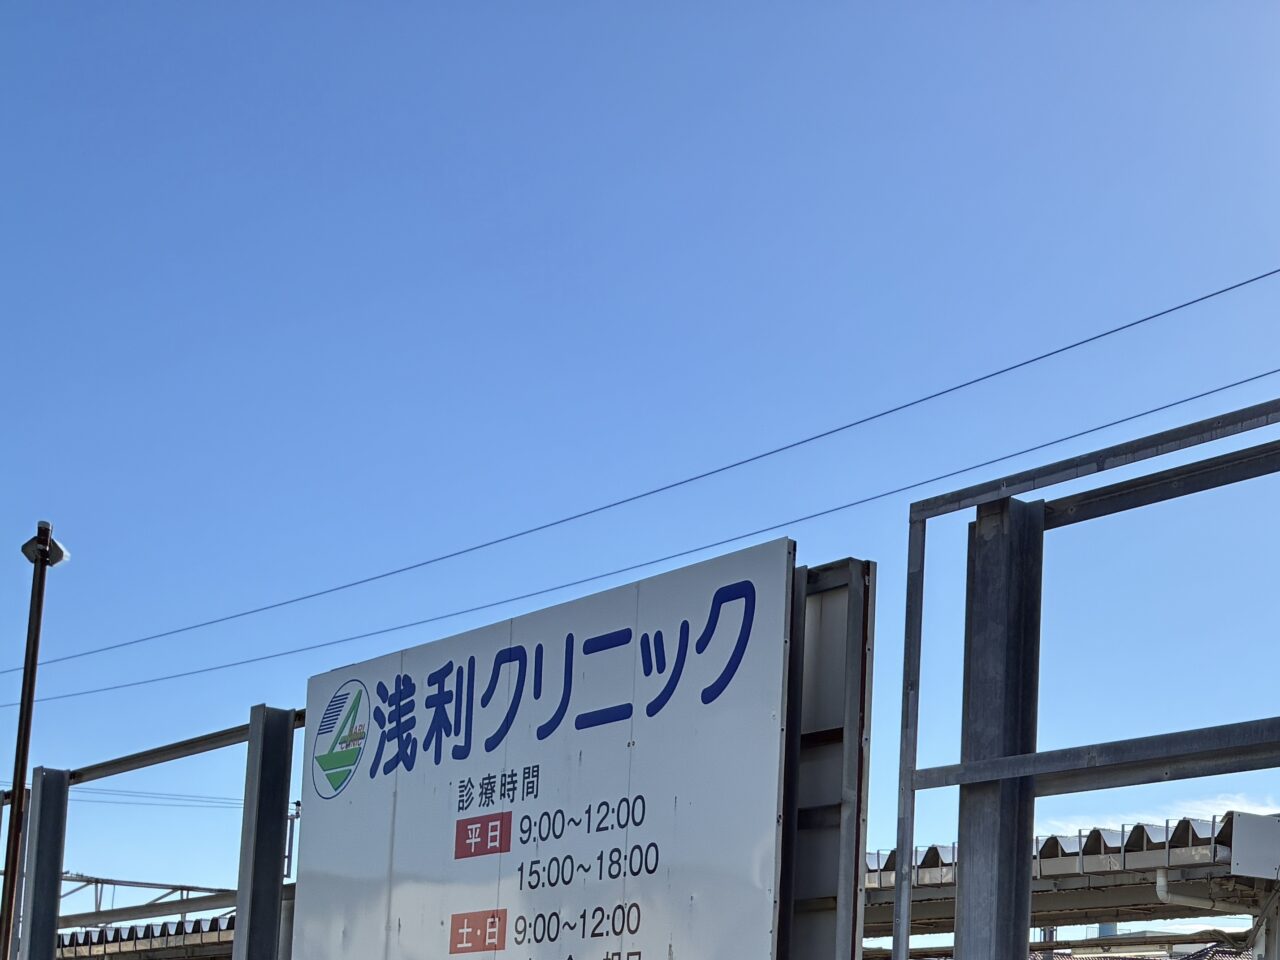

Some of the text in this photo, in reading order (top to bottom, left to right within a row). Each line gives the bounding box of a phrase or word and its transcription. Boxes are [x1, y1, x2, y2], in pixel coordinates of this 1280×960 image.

[369, 580, 757, 780] 浅利クリニック
[457, 764, 540, 813] 診療時間
[465, 820, 501, 853] 平日
[456, 917, 499, 949] 土・日
